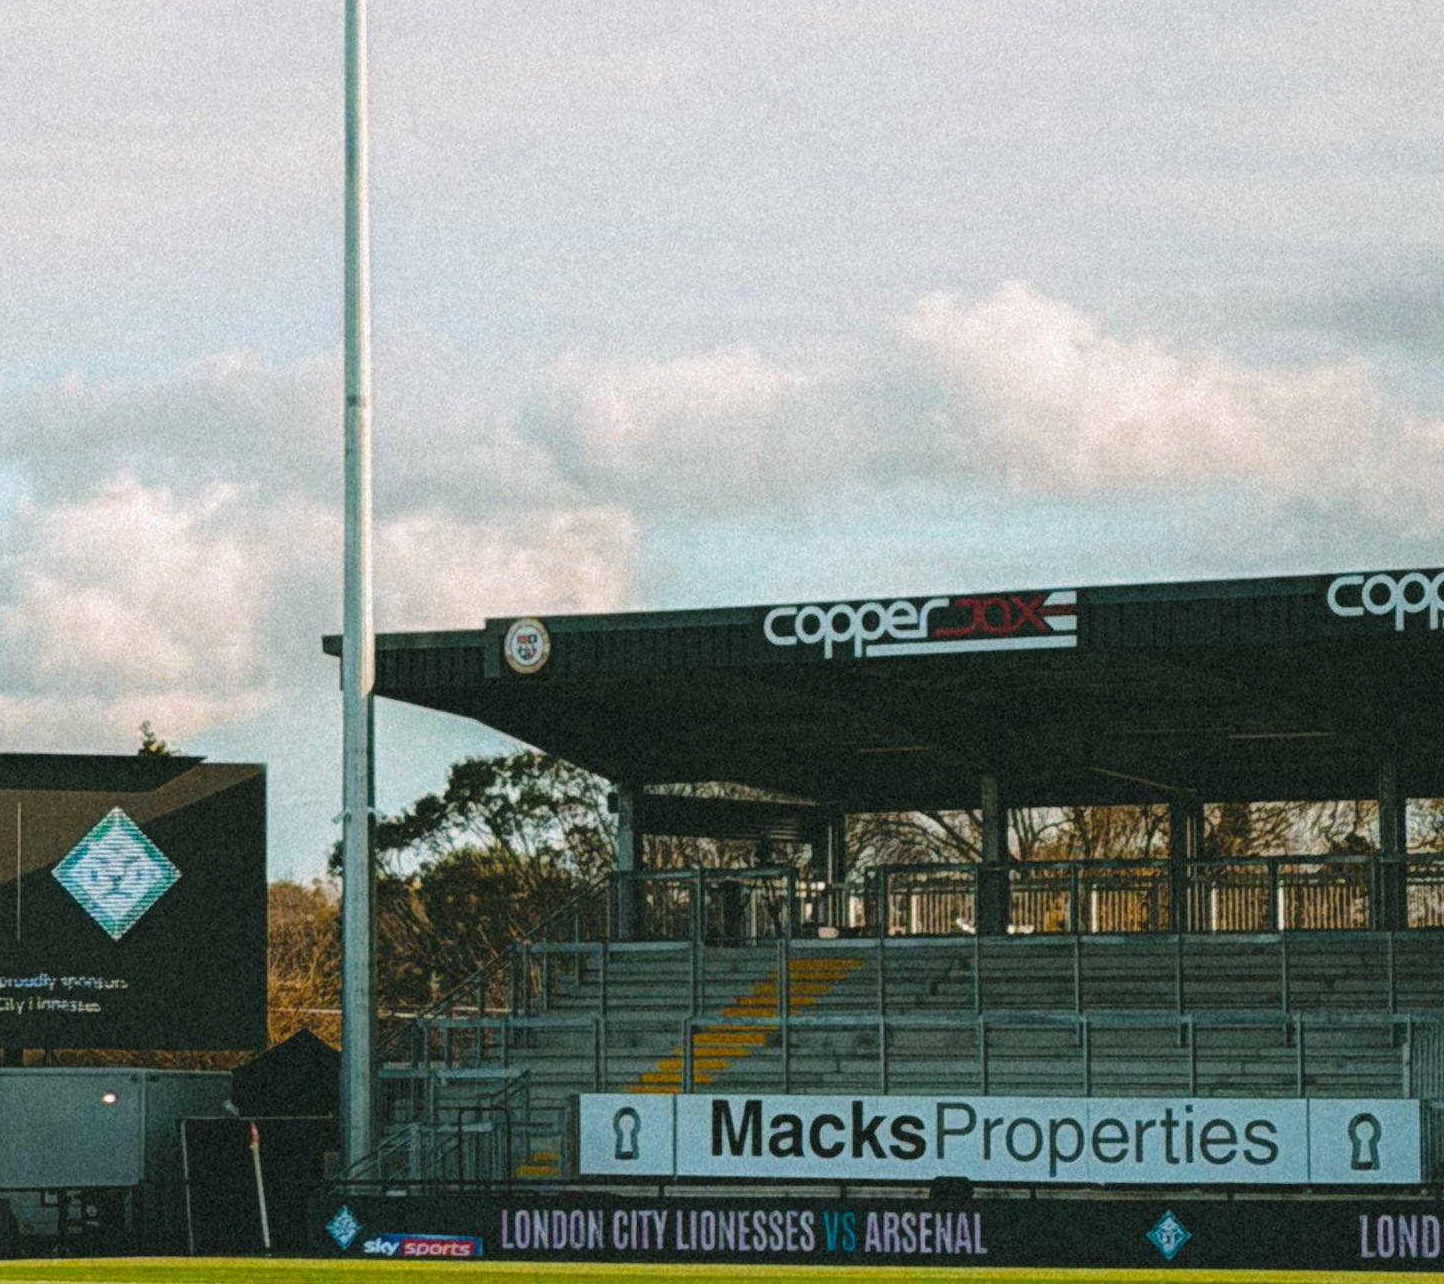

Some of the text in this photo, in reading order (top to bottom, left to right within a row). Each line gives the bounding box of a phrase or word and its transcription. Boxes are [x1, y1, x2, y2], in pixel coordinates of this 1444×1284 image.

[364, 1237, 471, 1256] sky sports
[502, 1210, 988, 1255] LONDON CITY LIONESSES VS ARSENAL
[1359, 1214, 1441, 1258] LOND
